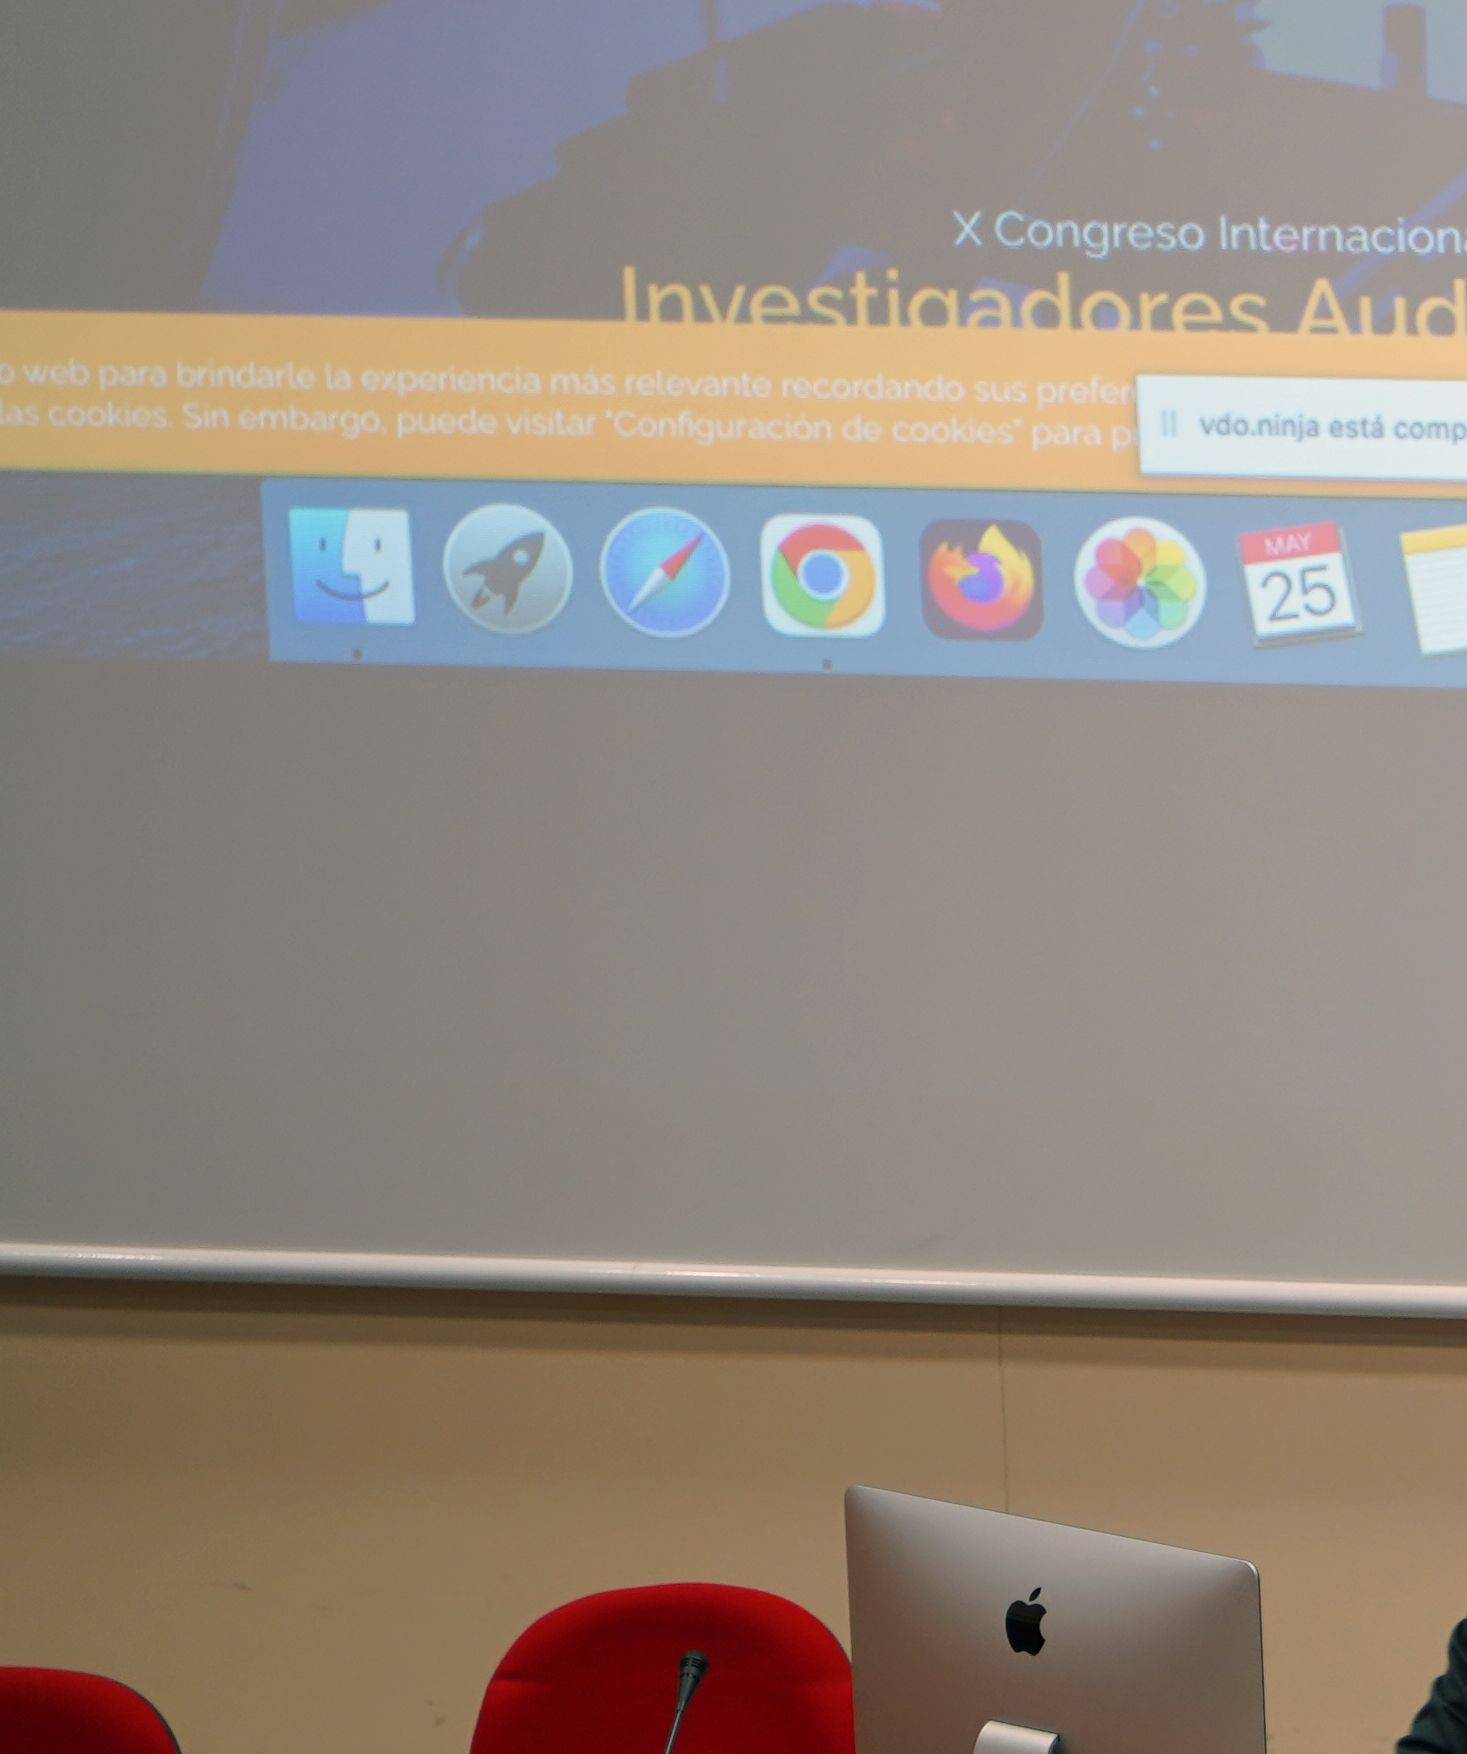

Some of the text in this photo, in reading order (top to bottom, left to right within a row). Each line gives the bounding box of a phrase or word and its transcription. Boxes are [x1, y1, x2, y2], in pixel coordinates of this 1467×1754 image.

[953, 211, 982, 248] X
[995, 211, 1206, 260] Congreso
[622, 266, 1269, 333] Investigadores
[23, 360, 90, 387] web
[100, 366, 167, 394] para
[177, 361, 316, 391] brindarle
[325, 363, 352, 391] la
[361, 366, 541, 398] experiencia
[550, 367, 616, 396] más
[625, 370, 772, 398] relevante
[781, 372, 965, 402] recordando
[974, 380, 1027, 404] sus
[48, 401, 173, 429] cookies.
[181, 404, 231, 430] Sin
[397, 406, 498, 440] puede
[506, 408, 597, 437] visitar
[842, 413, 884, 440] de
[1032, 423, 1102, 450] para
[1200, 410, 1320, 442] vdo.ninja
[1328, 413, 1385, 440] está
[1263, 534, 1312, 557] MAY
[1258, 563, 1338, 623] 25
